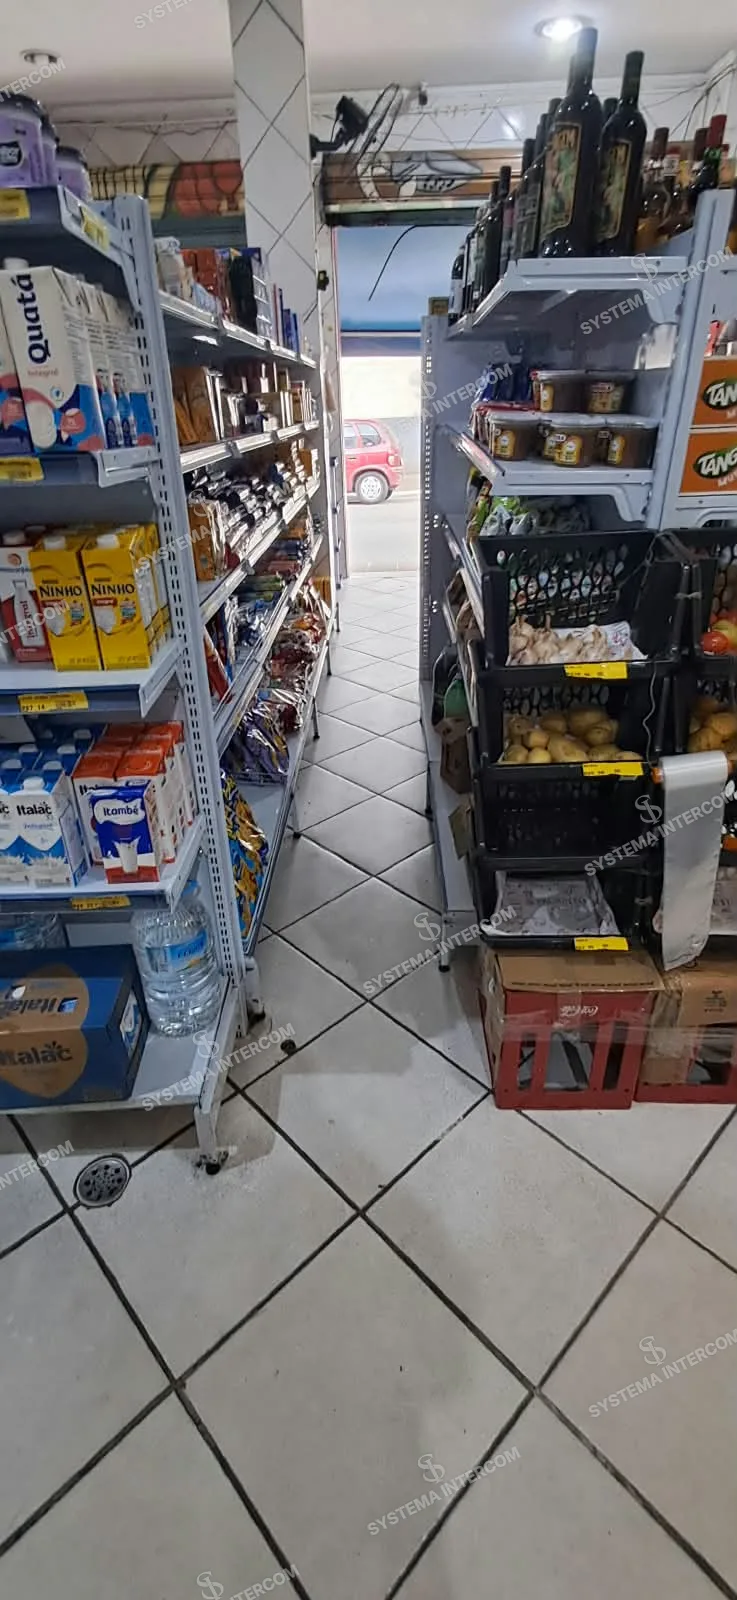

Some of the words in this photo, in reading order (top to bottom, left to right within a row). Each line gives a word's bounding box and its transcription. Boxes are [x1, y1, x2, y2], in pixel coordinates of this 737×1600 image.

[11, 274, 51, 364] Quatá
[706, 381, 737, 406] TAN
[39, 585, 82, 598] NINHO
[91, 583, 135, 596] NINHO
[16, 802, 52, 816] Italac
[103, 804, 139, 816] Itambé
